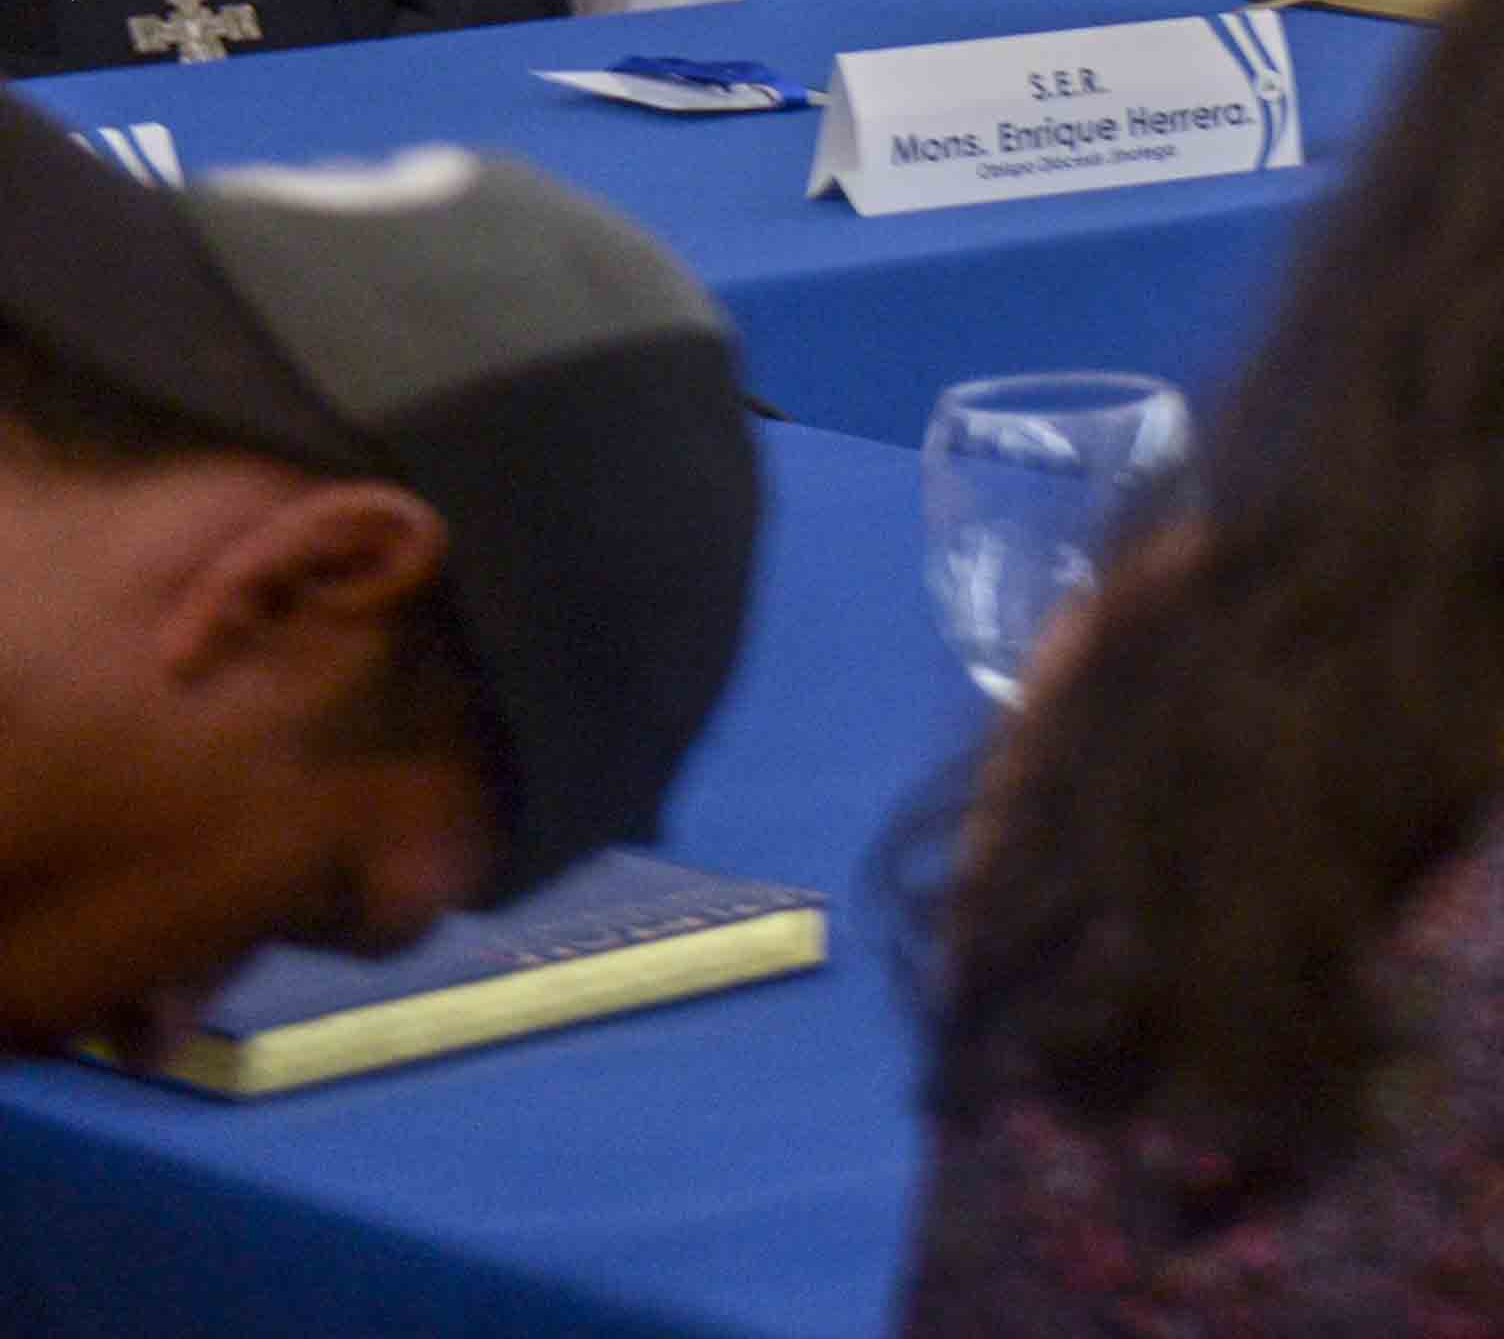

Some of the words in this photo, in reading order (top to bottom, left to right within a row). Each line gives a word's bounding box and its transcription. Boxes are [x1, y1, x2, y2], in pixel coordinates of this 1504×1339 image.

[1027, 67, 1111, 101] S.E.R.
[891, 133, 988, 166] Mons.
[997, 116, 1119, 154] Enrique
